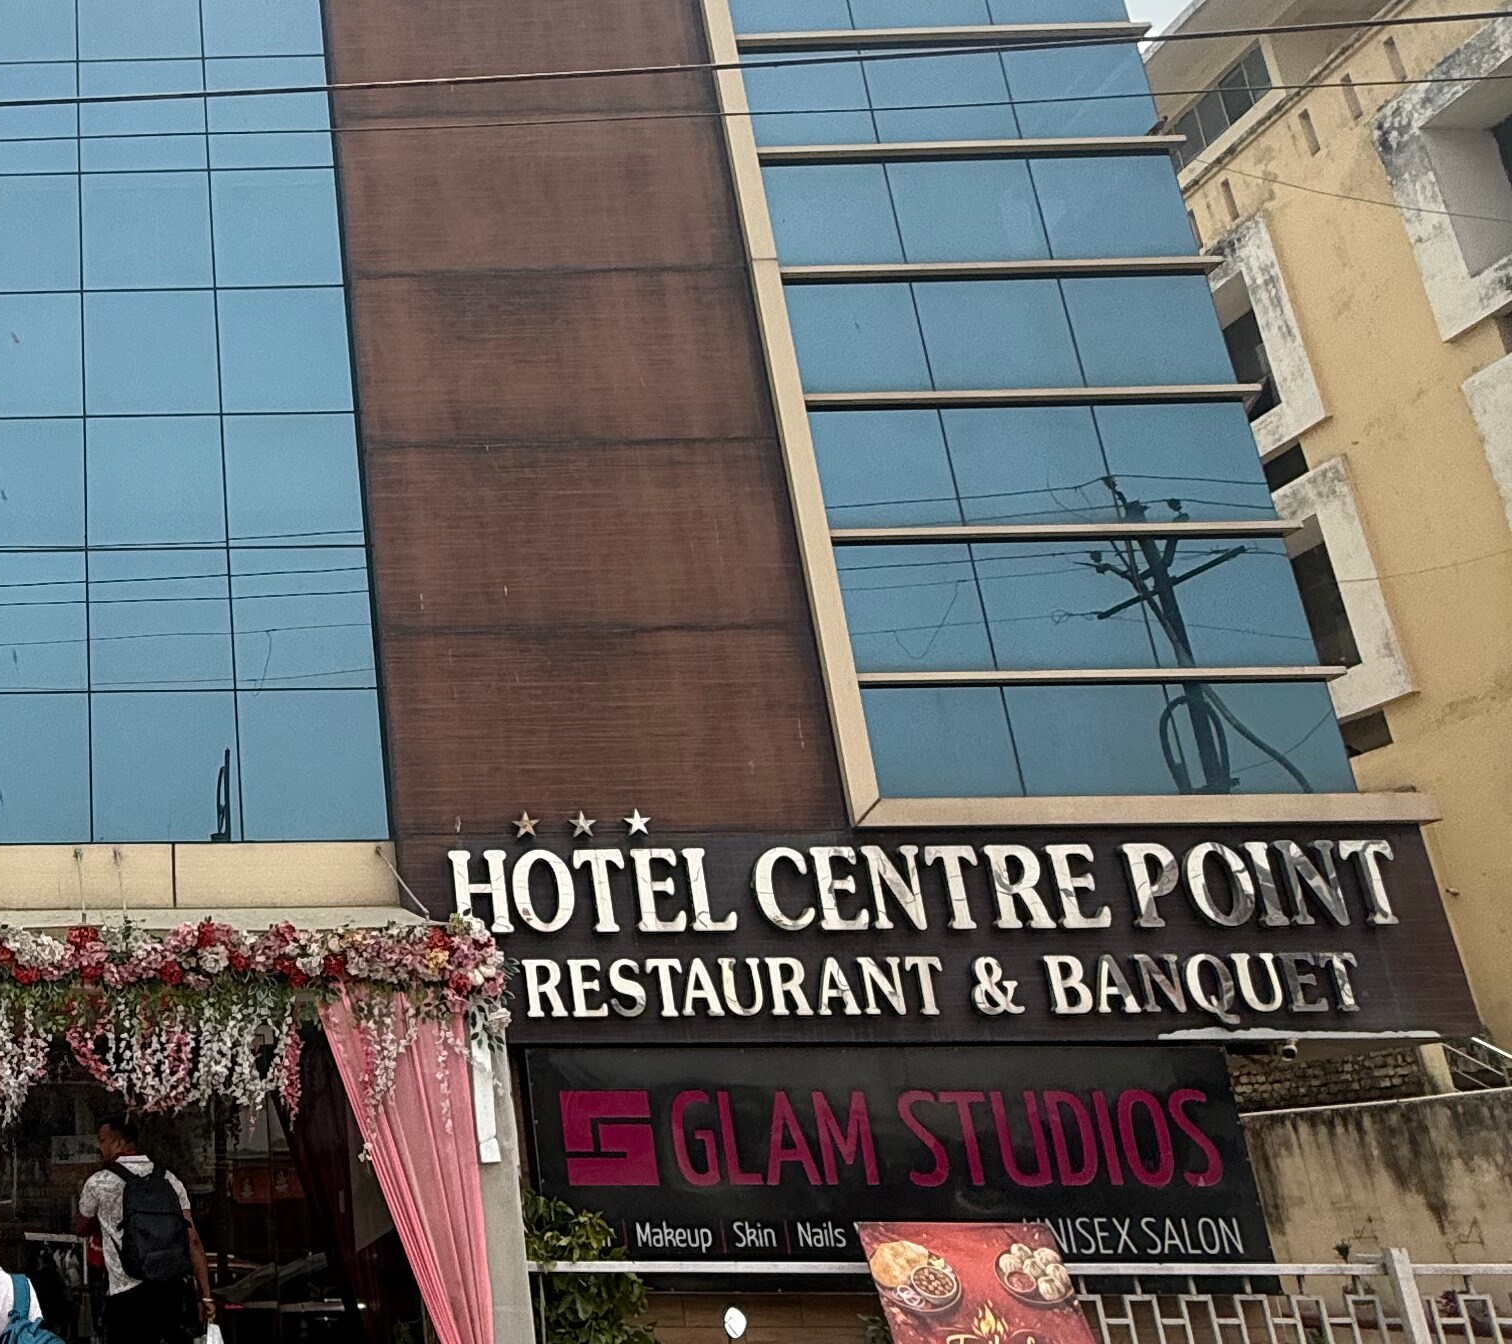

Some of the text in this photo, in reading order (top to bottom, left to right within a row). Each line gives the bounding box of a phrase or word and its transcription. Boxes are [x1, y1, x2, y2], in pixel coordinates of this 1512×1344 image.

[450, 839, 1402, 936] HOTEL CENTRE POINT
[523, 951, 1361, 1025] RESTAURANT & BANQUET
[670, 1088, 1224, 1188] GLAM STUDIOS
[635, 1220, 713, 1253] Makeup
[732, 1221, 777, 1248] Skin
[796, 1220, 847, 1248] Nails
[1140, 1217, 1245, 1255] SALON
